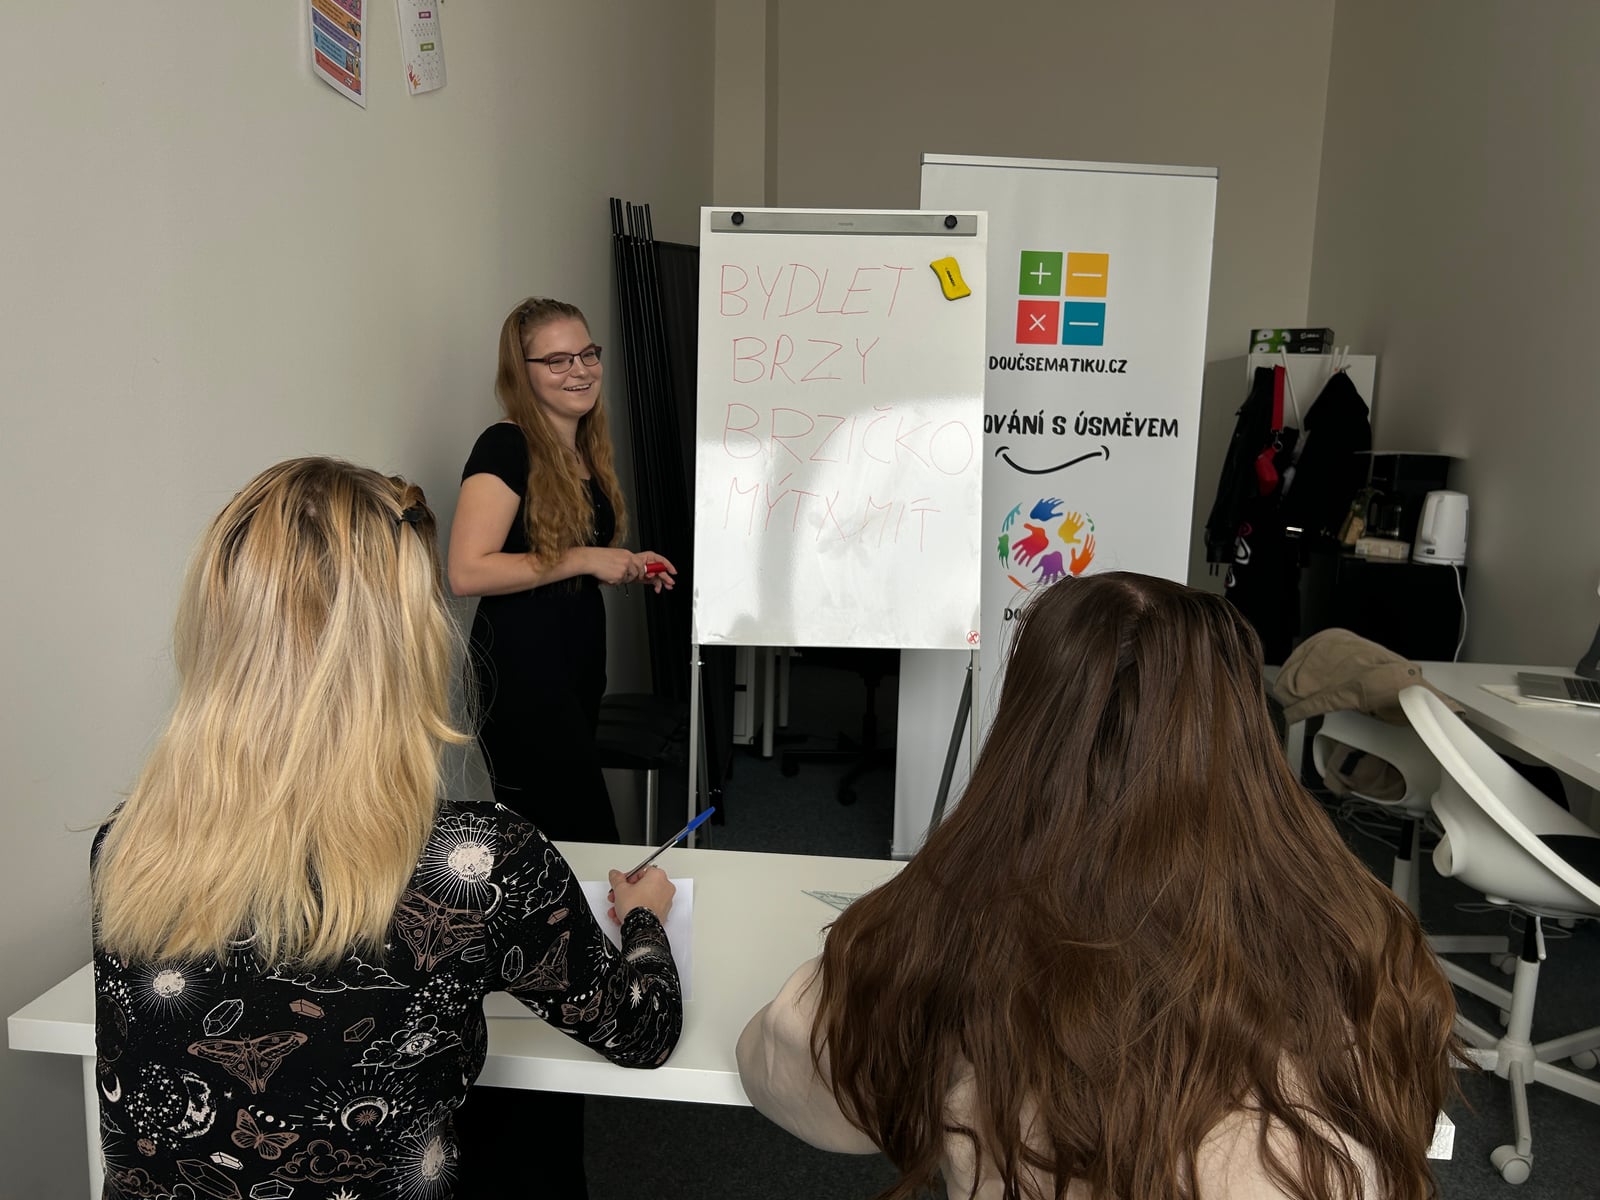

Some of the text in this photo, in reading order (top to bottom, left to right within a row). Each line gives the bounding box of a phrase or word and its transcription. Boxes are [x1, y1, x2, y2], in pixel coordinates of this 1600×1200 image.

[720, 263, 914, 320] BYDLET
[732, 334, 880, 385] BRZY
[988, 353, 1128, 374] DOUČSEMATIKU.CZ
[723, 403, 974, 475] BRZIČKO
[1052, 415, 1067, 435] S
[1074, 410, 1179, 438] ÚSMĚVEM
[723, 473, 819, 536] MÝT
